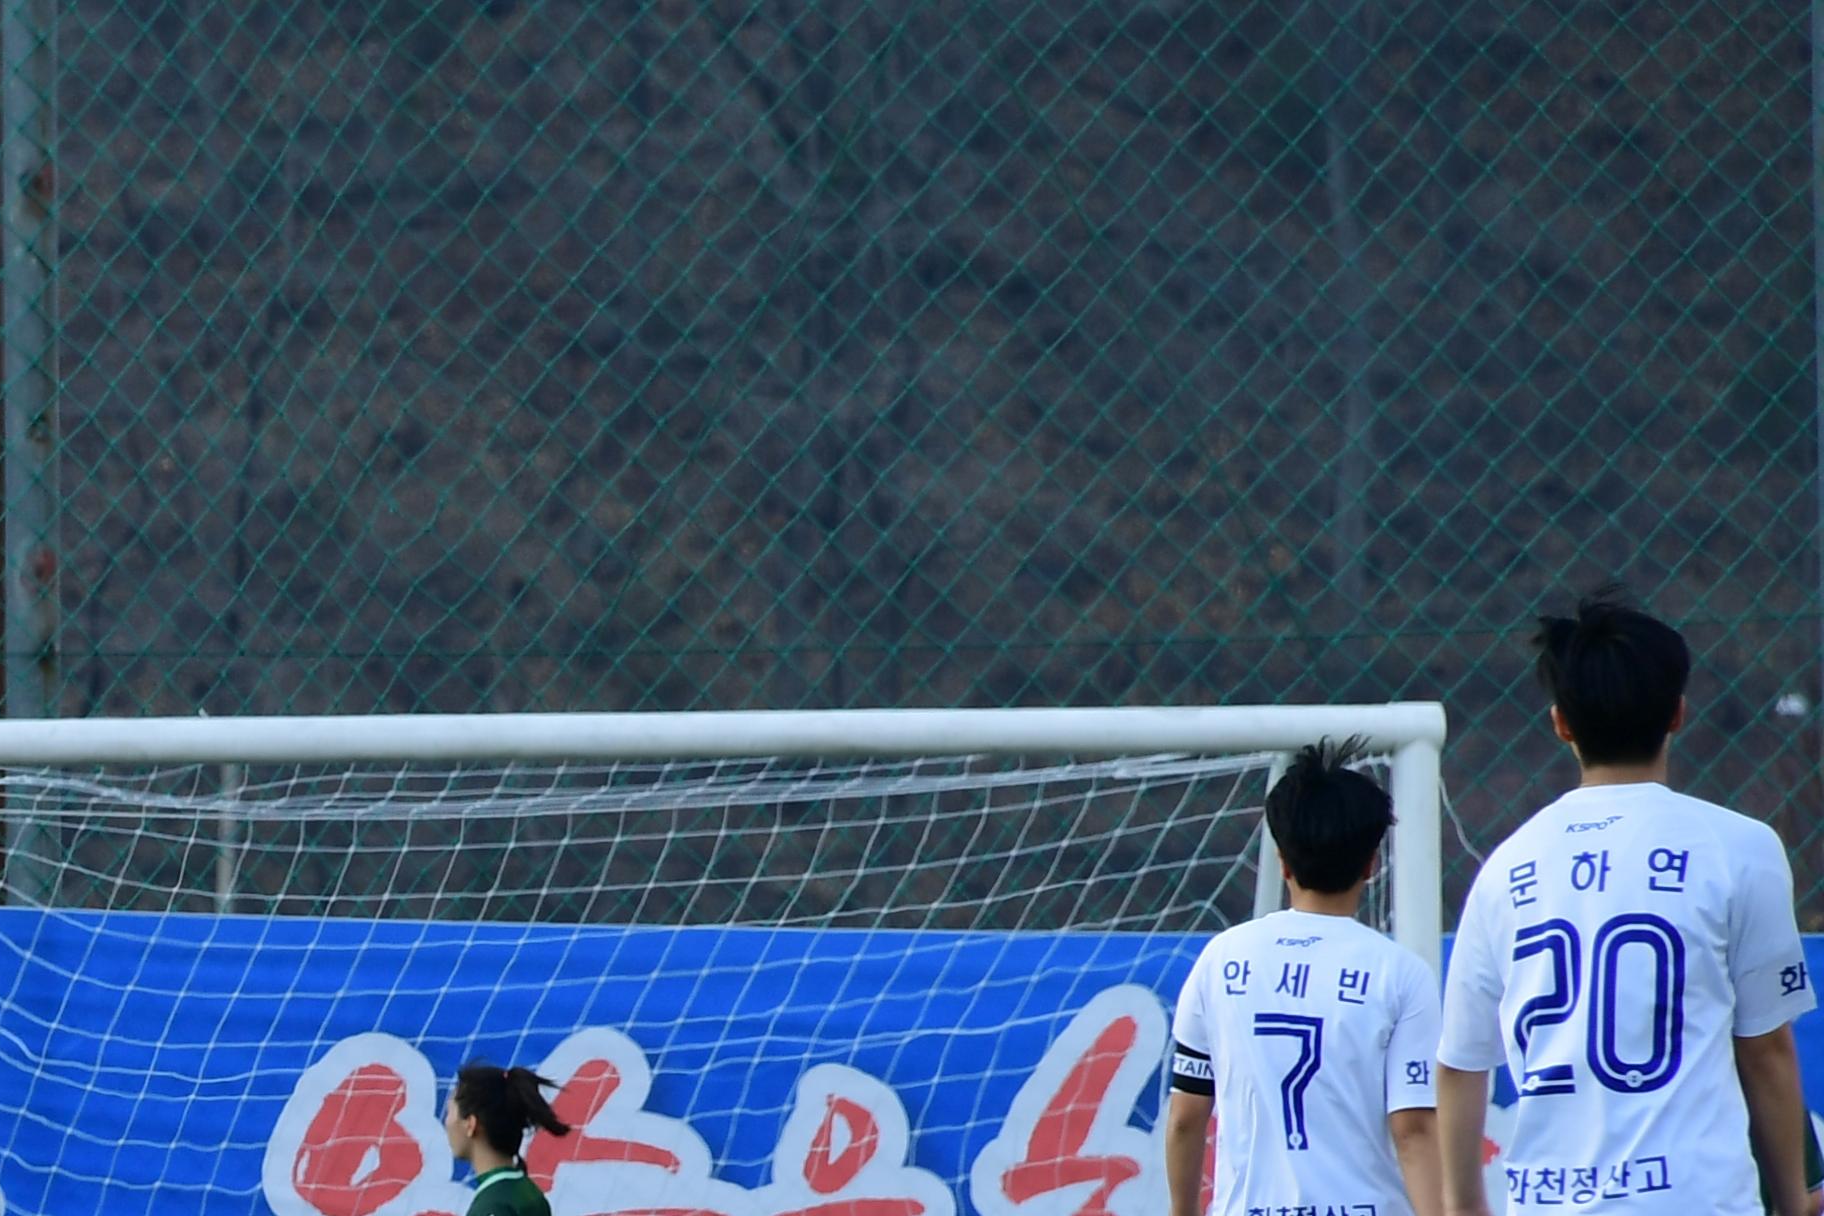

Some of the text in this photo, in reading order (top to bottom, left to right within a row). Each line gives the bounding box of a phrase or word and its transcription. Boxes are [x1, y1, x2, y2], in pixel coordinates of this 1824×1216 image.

[1511, 912, 1687, 1097] 20
[1254, 1012, 1324, 1151] 7
[1504, 1154, 1673, 1206] 화천정산고
